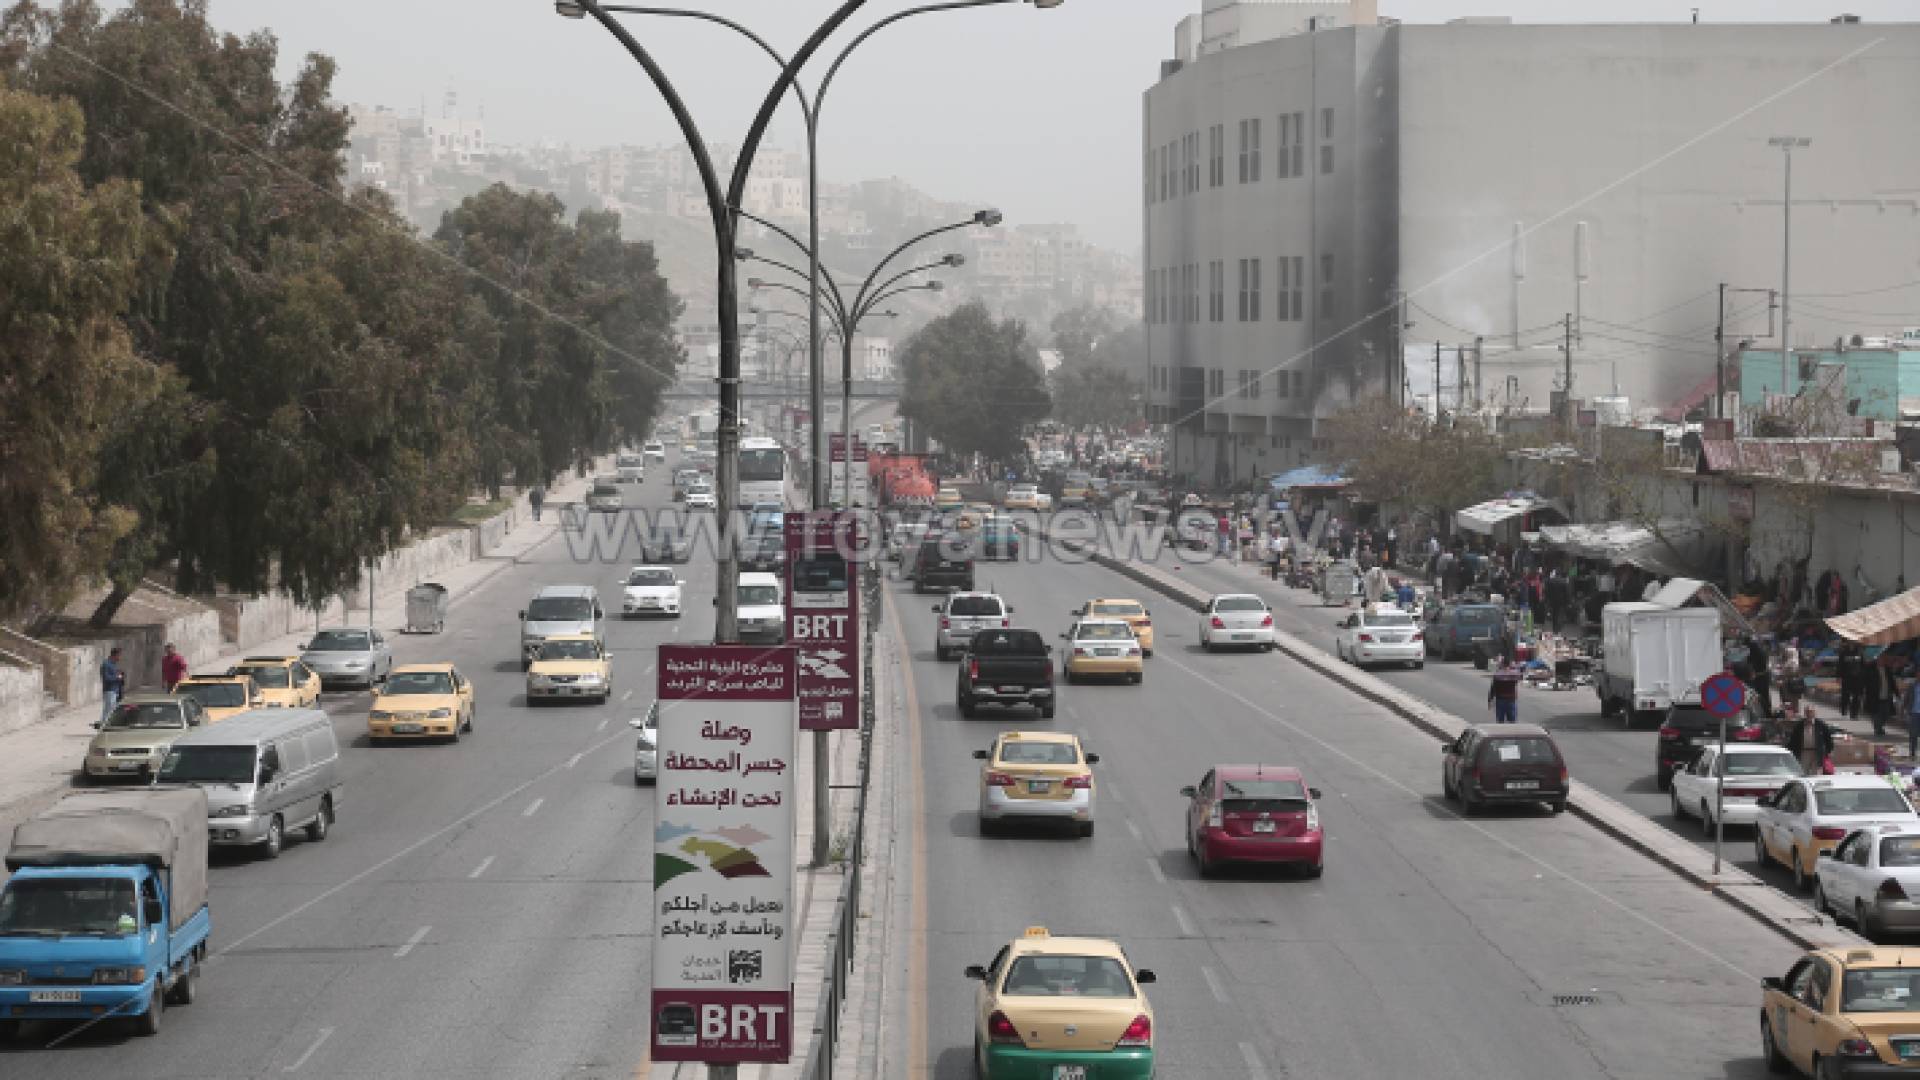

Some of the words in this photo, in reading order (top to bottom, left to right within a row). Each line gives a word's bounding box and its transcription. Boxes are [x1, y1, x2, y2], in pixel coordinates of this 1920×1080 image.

[793, 614, 848, 638] BRT
[701, 720, 751, 745] وصلة
[665, 751, 741, 773] المحطة
[742, 758, 786, 778] جسر
[666, 788, 737, 810] الإنشاء
[742, 790, 781, 808] تحت
[710, 901, 740, 916] من
[701, 1004, 785, 1041] BRT
